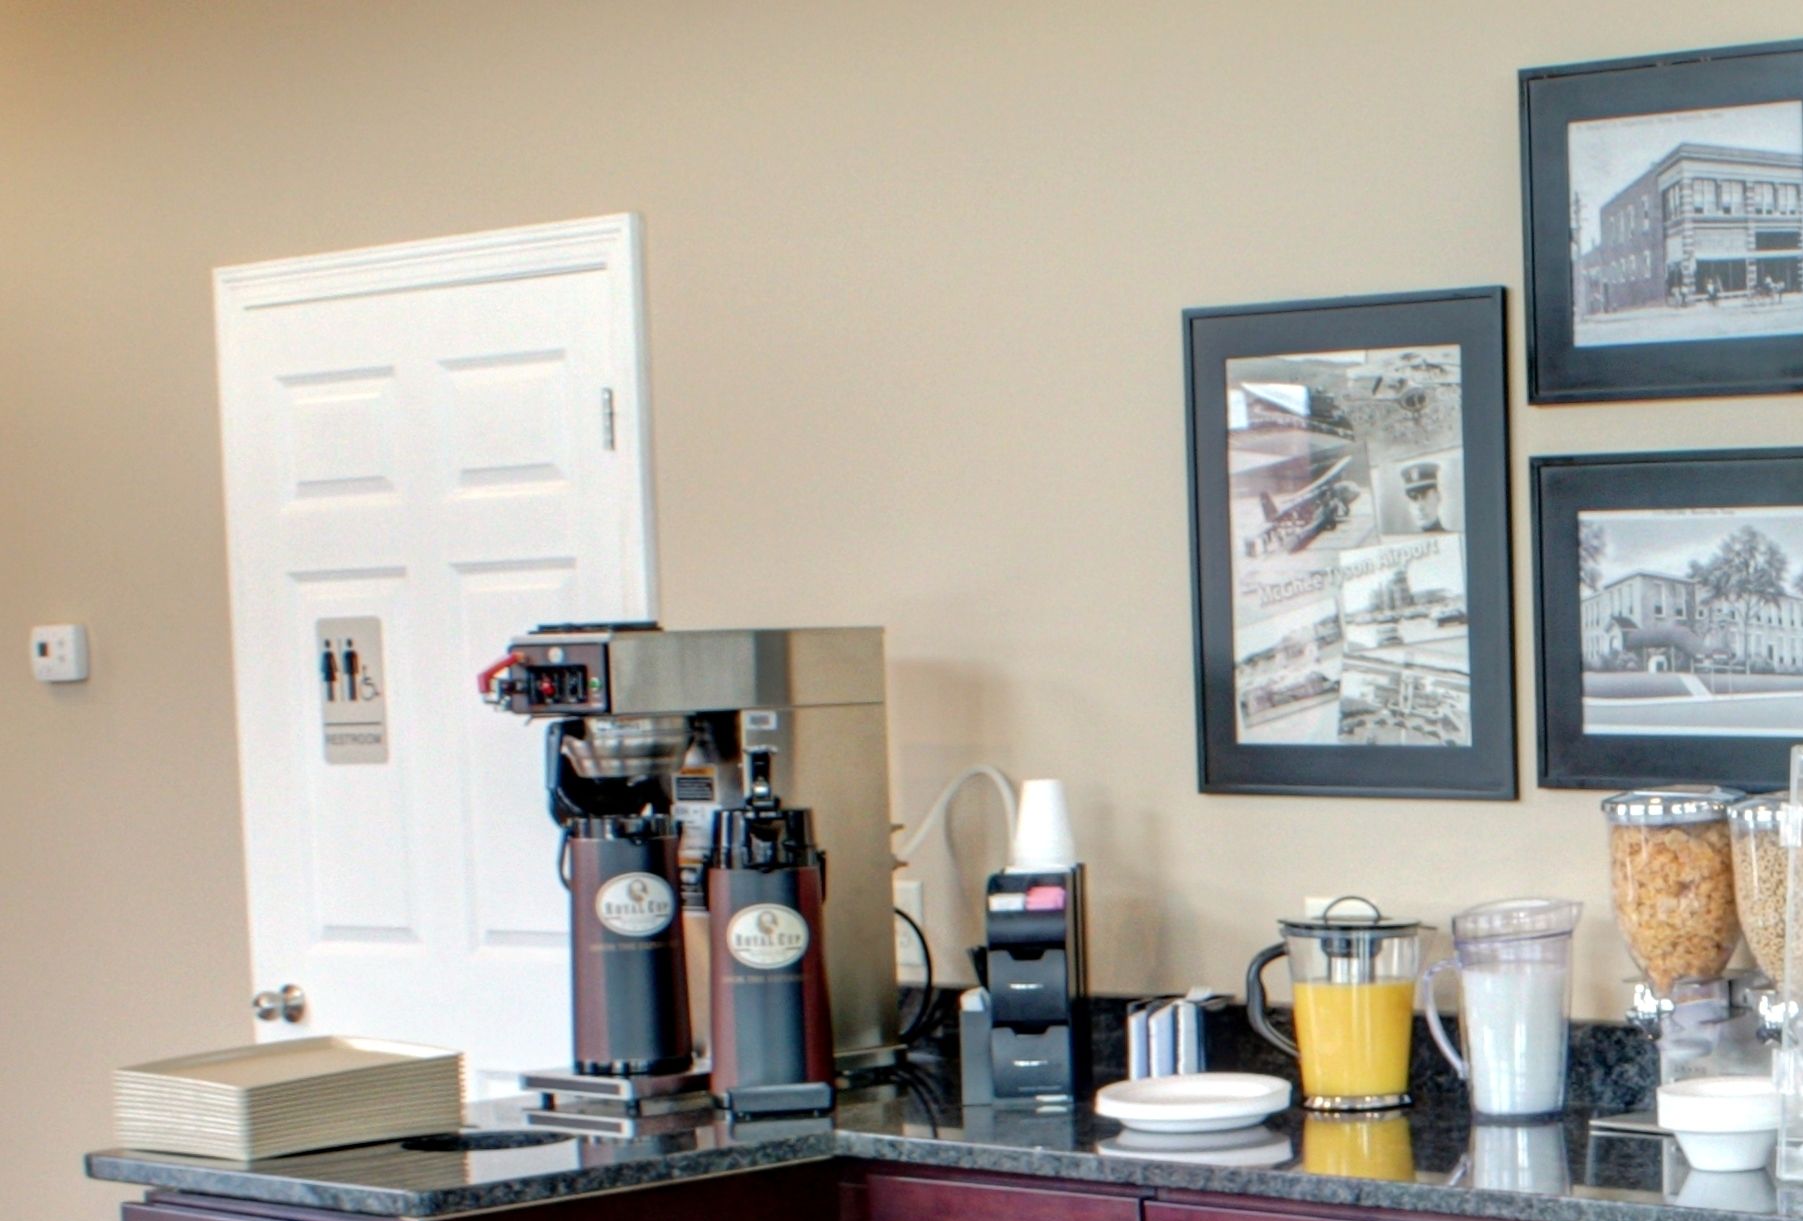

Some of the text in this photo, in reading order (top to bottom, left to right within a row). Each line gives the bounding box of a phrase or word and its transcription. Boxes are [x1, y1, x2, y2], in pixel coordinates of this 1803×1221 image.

[1258, 539, 1441, 607] McGhee Tyson Airport
[325, 732, 382, 746] RESTROOM
[735, 931, 801, 946] ROYAL CUP
